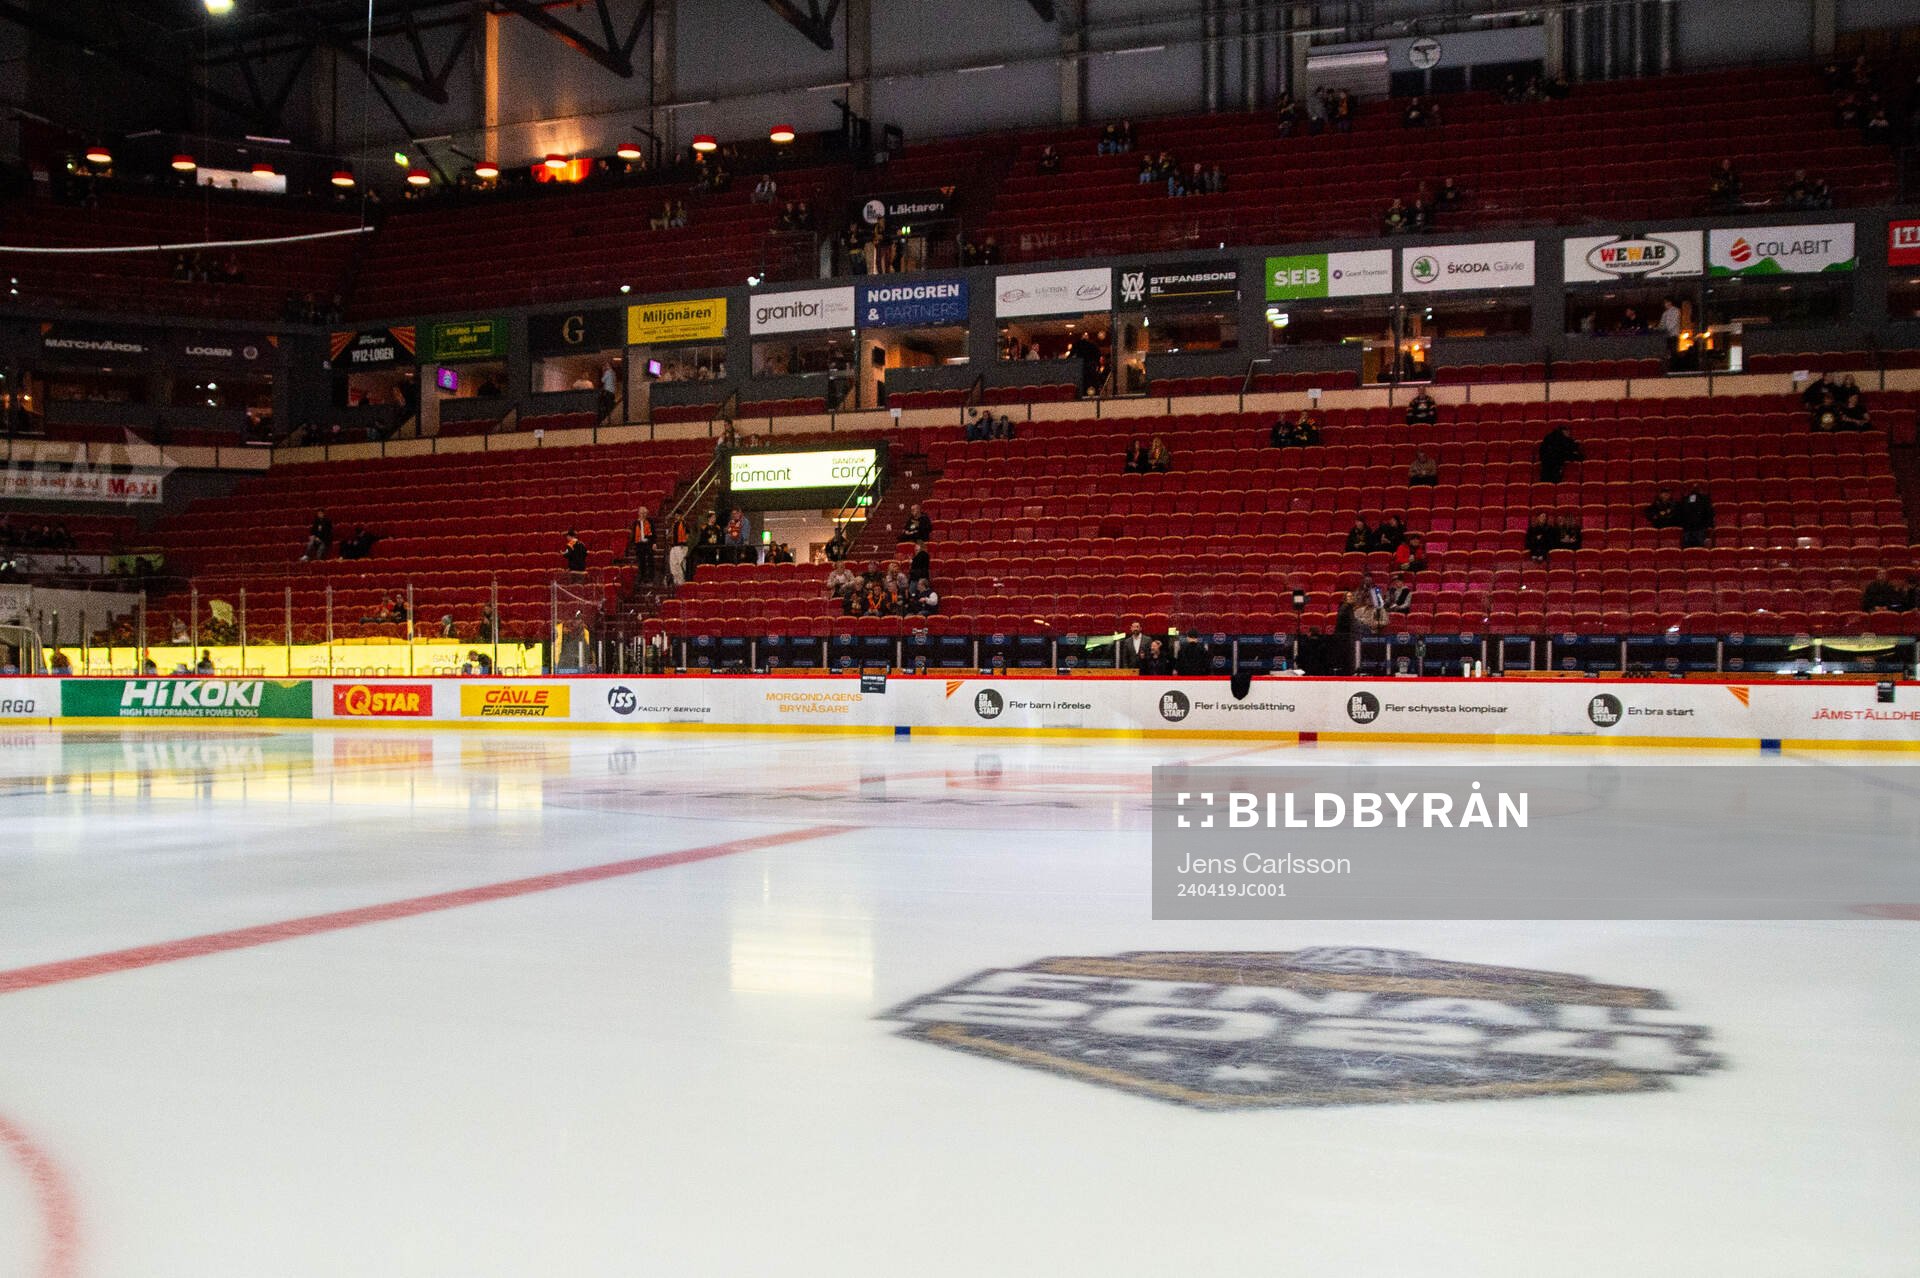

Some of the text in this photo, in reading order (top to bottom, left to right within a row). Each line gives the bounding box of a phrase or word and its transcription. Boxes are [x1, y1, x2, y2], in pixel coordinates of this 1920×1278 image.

[1600, 245, 1665, 262] WEWAB
[1756, 239, 1832, 257] COLABIT
[1447, 261, 1490, 274] ŠKODA
[1150, 271, 1236, 285] STEFANSSONS
[1274, 268, 1321, 287] SEB
[867, 284, 959, 303] NORDGREN
[1150, 286, 1164, 294] EL
[643, 308, 711, 325] Miljönären
[756, 301, 820, 324] granitor
[867, 303, 958, 321] & PARTNERS
[186, 346, 232, 357] LOGEN
[485, 686, 549, 703] GÄVLE
[766, 693, 863, 702] MORGONDAGENS
[1164, 694, 1174, 702] EN
[1, 700, 35, 713] RGO
[1009, 701, 1028, 709] Fler
[1030, 701, 1051, 709] barn
[1057, 701, 1091, 710] rörelse
[1195, 702, 1213, 711] Fler
[1220, 702, 1295, 713] sysselsättning
[1352, 704, 1367, 712] BRA
[1594, 699, 1604, 707] EN
[120, 708, 259, 717] HIGH PERFORMANCE POWER TOOLS
[979, 707, 999, 715] START
[1164, 709, 1185, 717] START
[1385, 704, 1508, 715] Fler schyssta kompisar
[1594, 706, 1609, 714] BRA
[1628, 707, 1694, 716] En bra start
[1352, 711, 1374, 720] START
[1593, 714, 1617, 722] START
